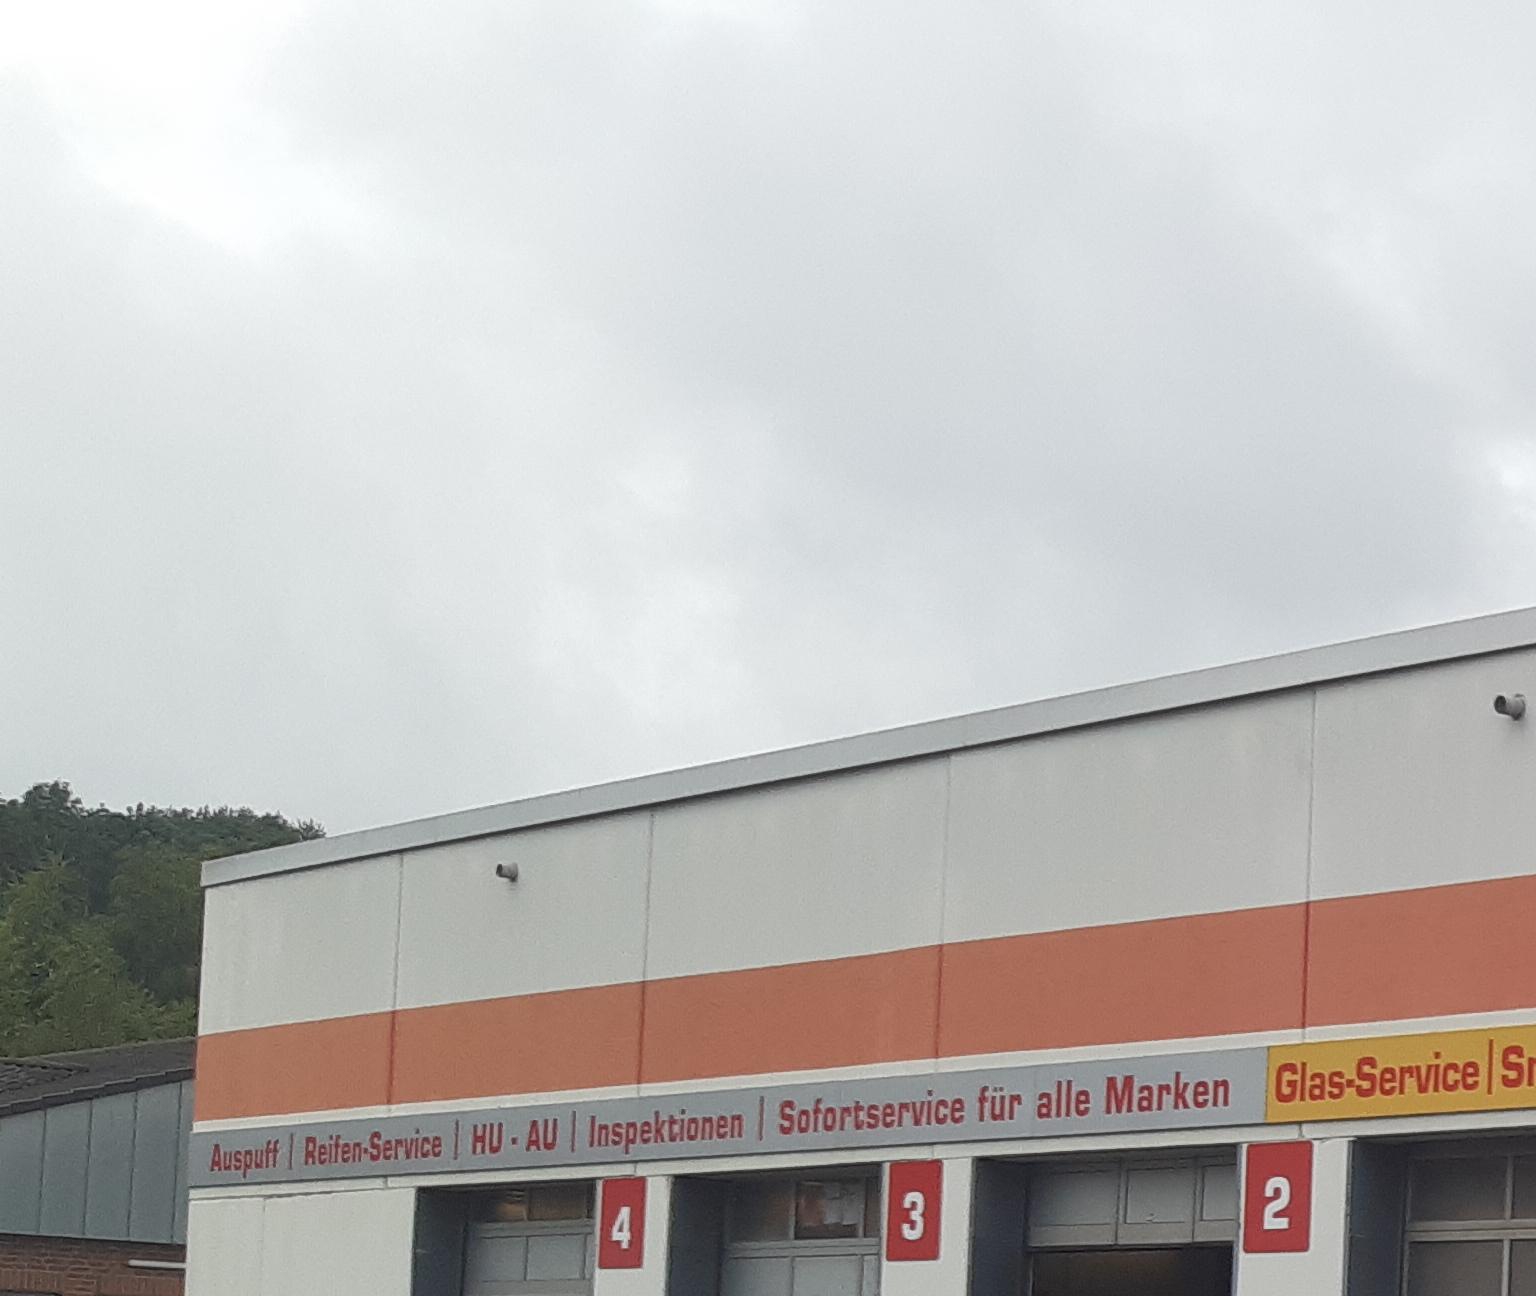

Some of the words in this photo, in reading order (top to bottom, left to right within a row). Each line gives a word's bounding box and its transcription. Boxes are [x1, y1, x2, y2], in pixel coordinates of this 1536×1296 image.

[1275, 1051, 1480, 1103] Glas-Service
[210, 1138, 280, 1177] Auspuff
[304, 1128, 442, 1167] Reifen-Service
[471, 1123, 504, 1156] HU
[525, 1117, 558, 1152] AU
[590, 1108, 744, 1155] Inspektionen
[778, 1089, 965, 1137] Sofortservice
[978, 1086, 1023, 1122] für
[1036, 1079, 1091, 1119] alle
[1104, 1071, 1231, 1115] Marken
[611, 1206, 631, 1249] 4
[902, 1191, 926, 1241] 3
[1262, 1176, 1291, 1230] 2
